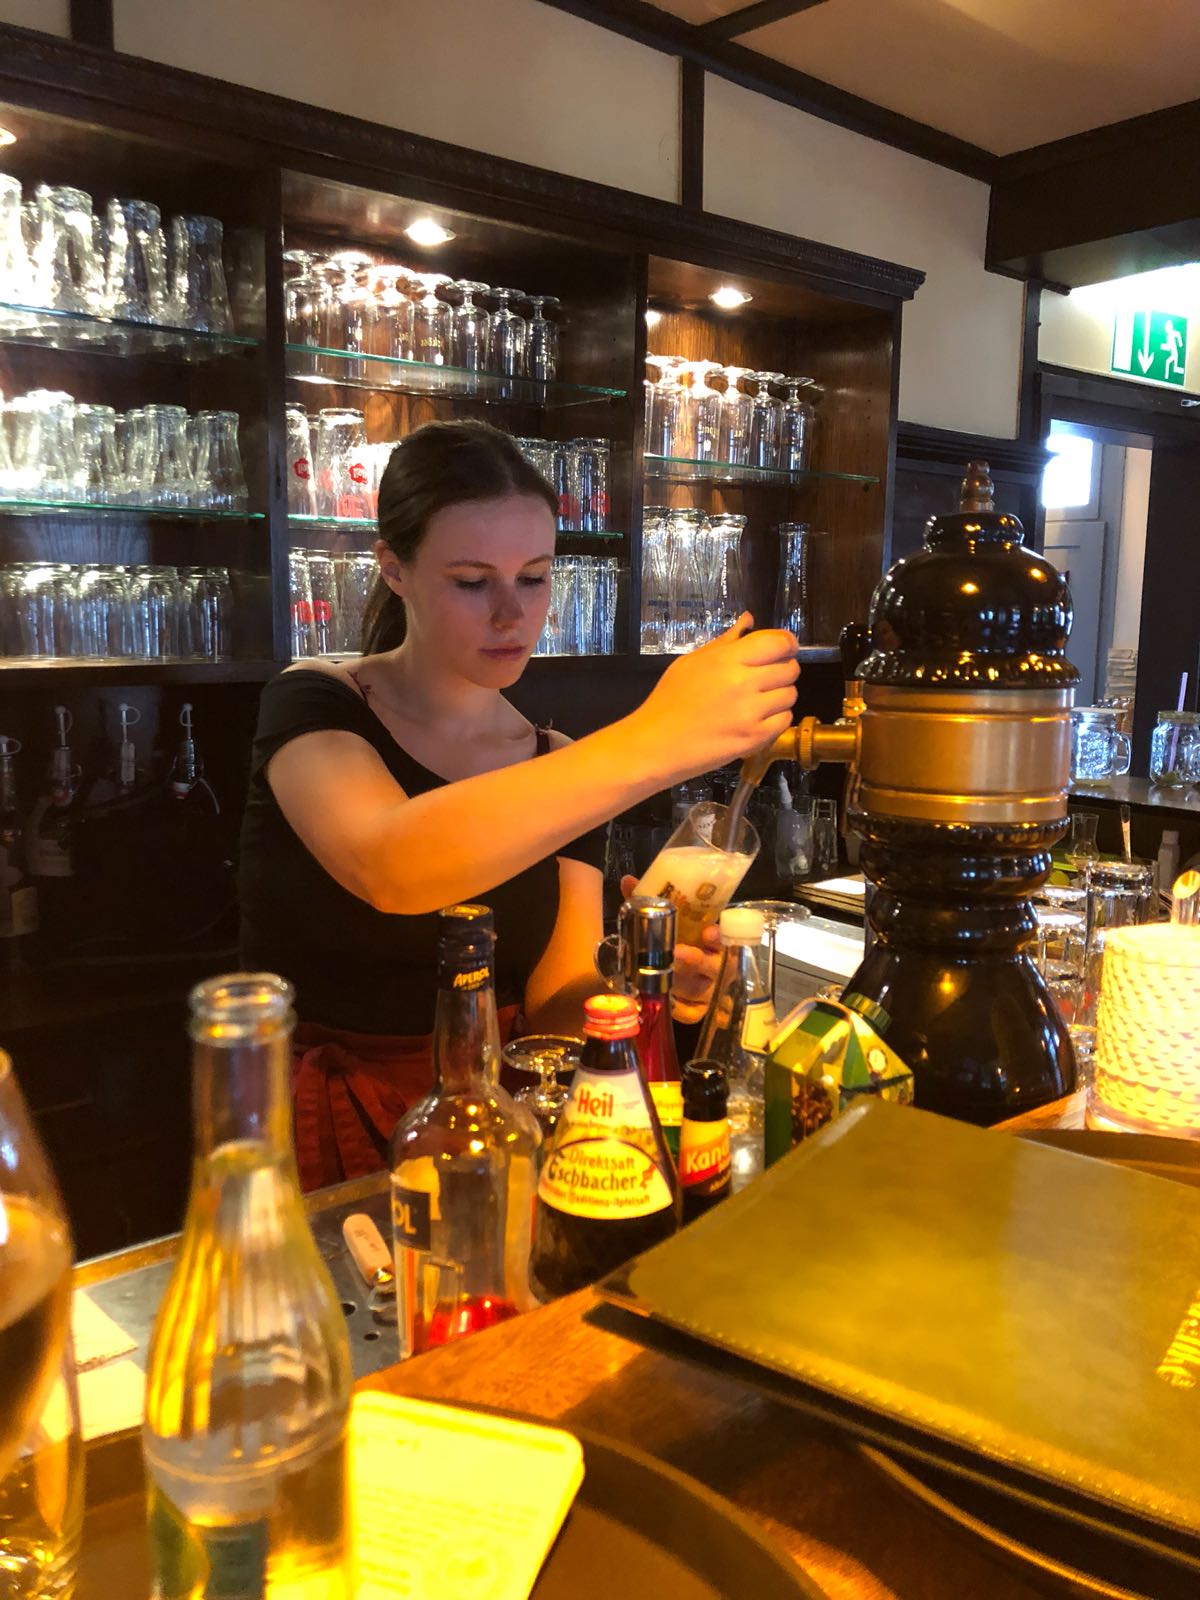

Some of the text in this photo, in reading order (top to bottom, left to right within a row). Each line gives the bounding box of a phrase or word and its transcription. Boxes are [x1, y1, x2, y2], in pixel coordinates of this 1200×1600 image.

[577, 1088, 614, 1118] Heil
[547, 1150, 637, 1193] Eschbacher
[568, 1146, 635, 1169] Direktsaft
